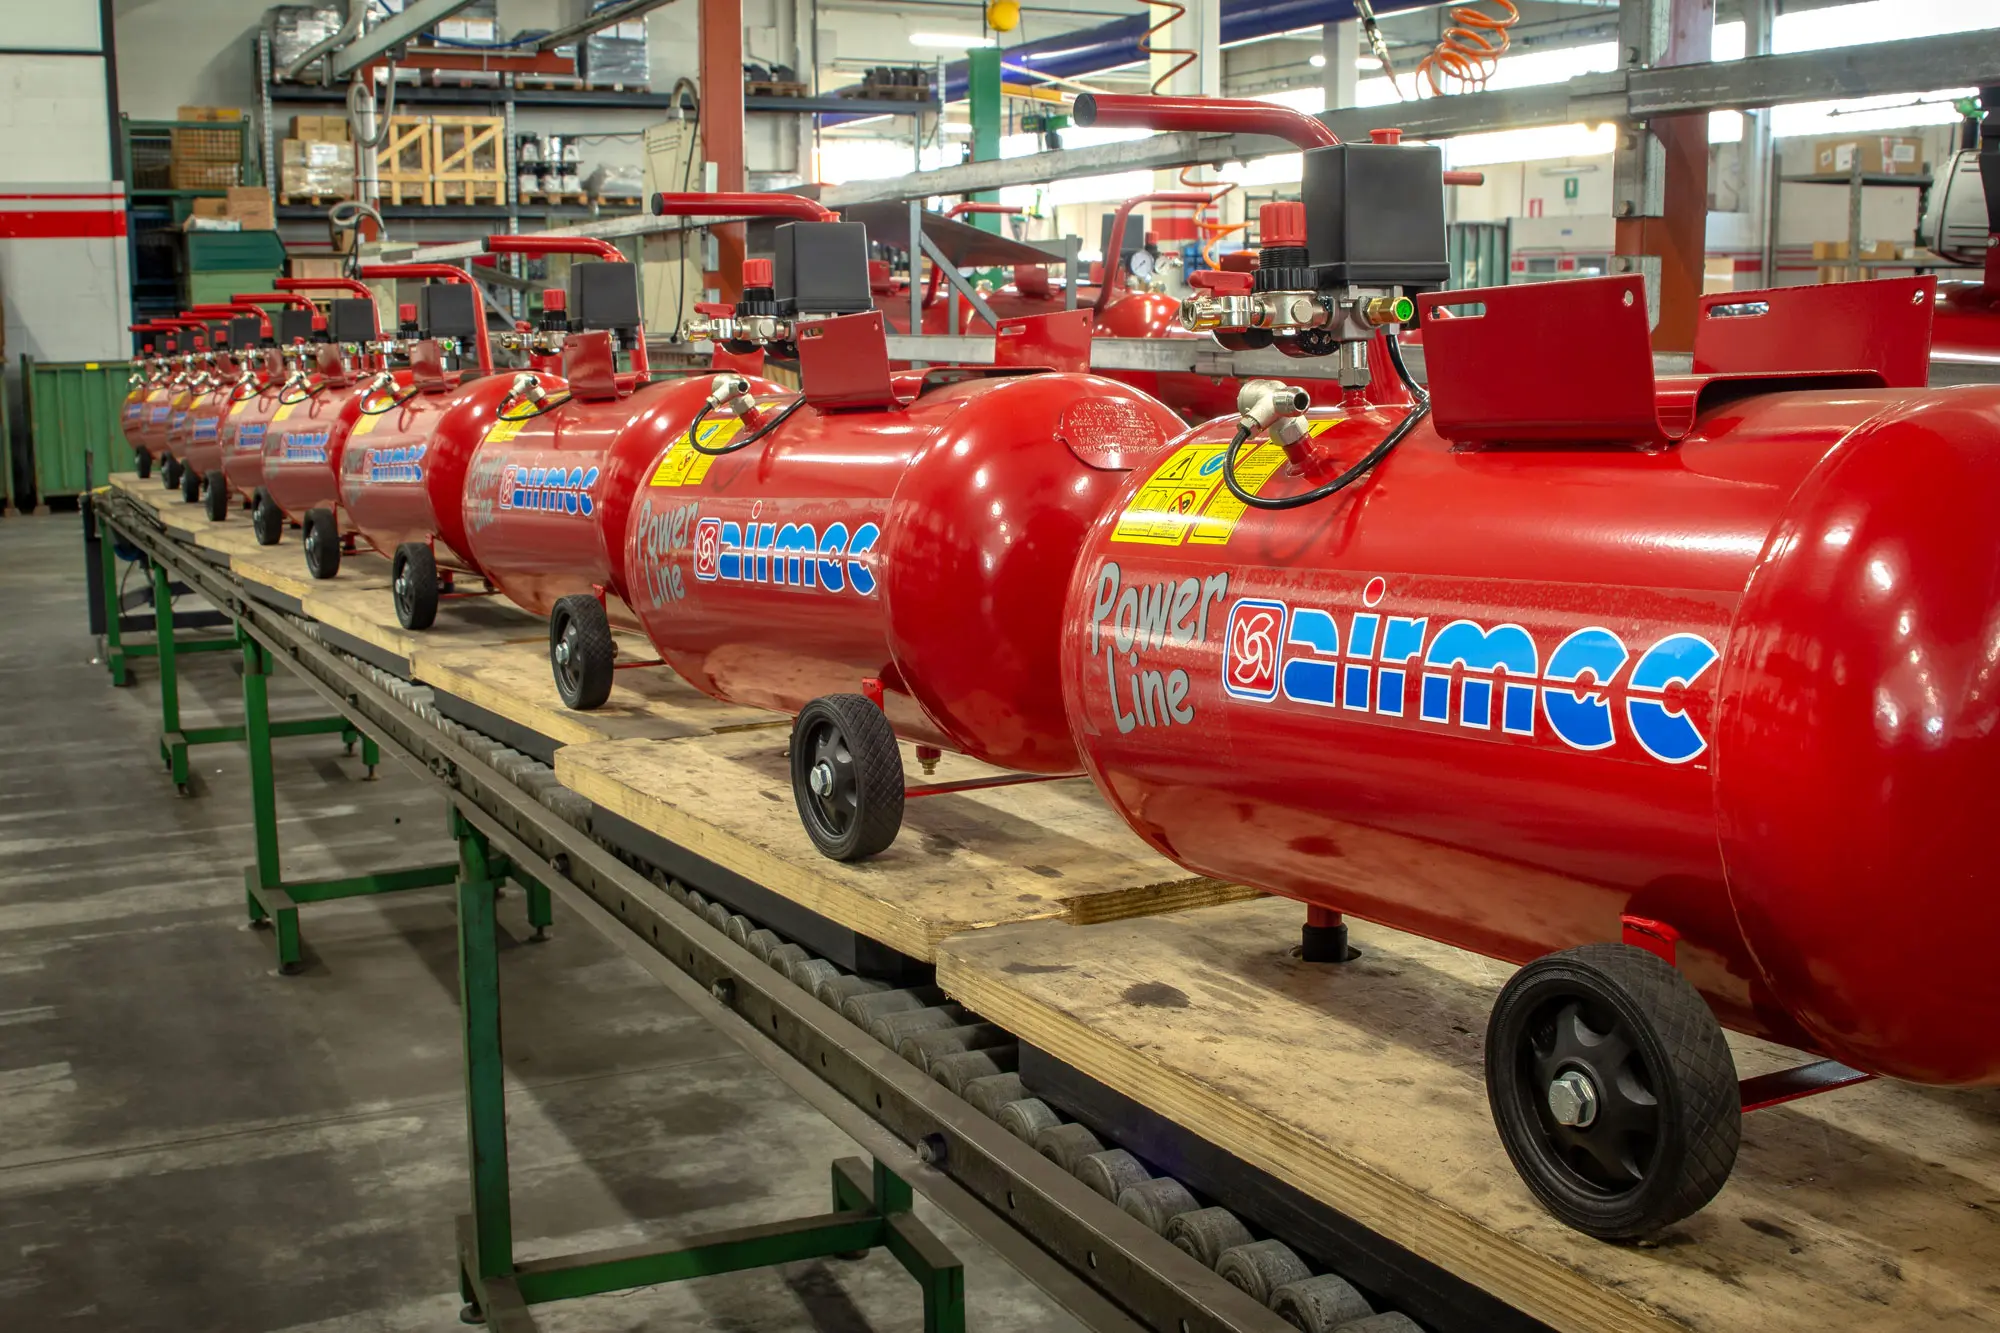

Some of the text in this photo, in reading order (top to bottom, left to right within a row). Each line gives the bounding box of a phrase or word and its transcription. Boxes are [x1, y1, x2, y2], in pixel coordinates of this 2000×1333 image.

[637, 499, 699, 560] Power
[644, 553, 686, 610] Line
[1092, 561, 1229, 656] Power
[1106, 651, 1196, 734] Line
